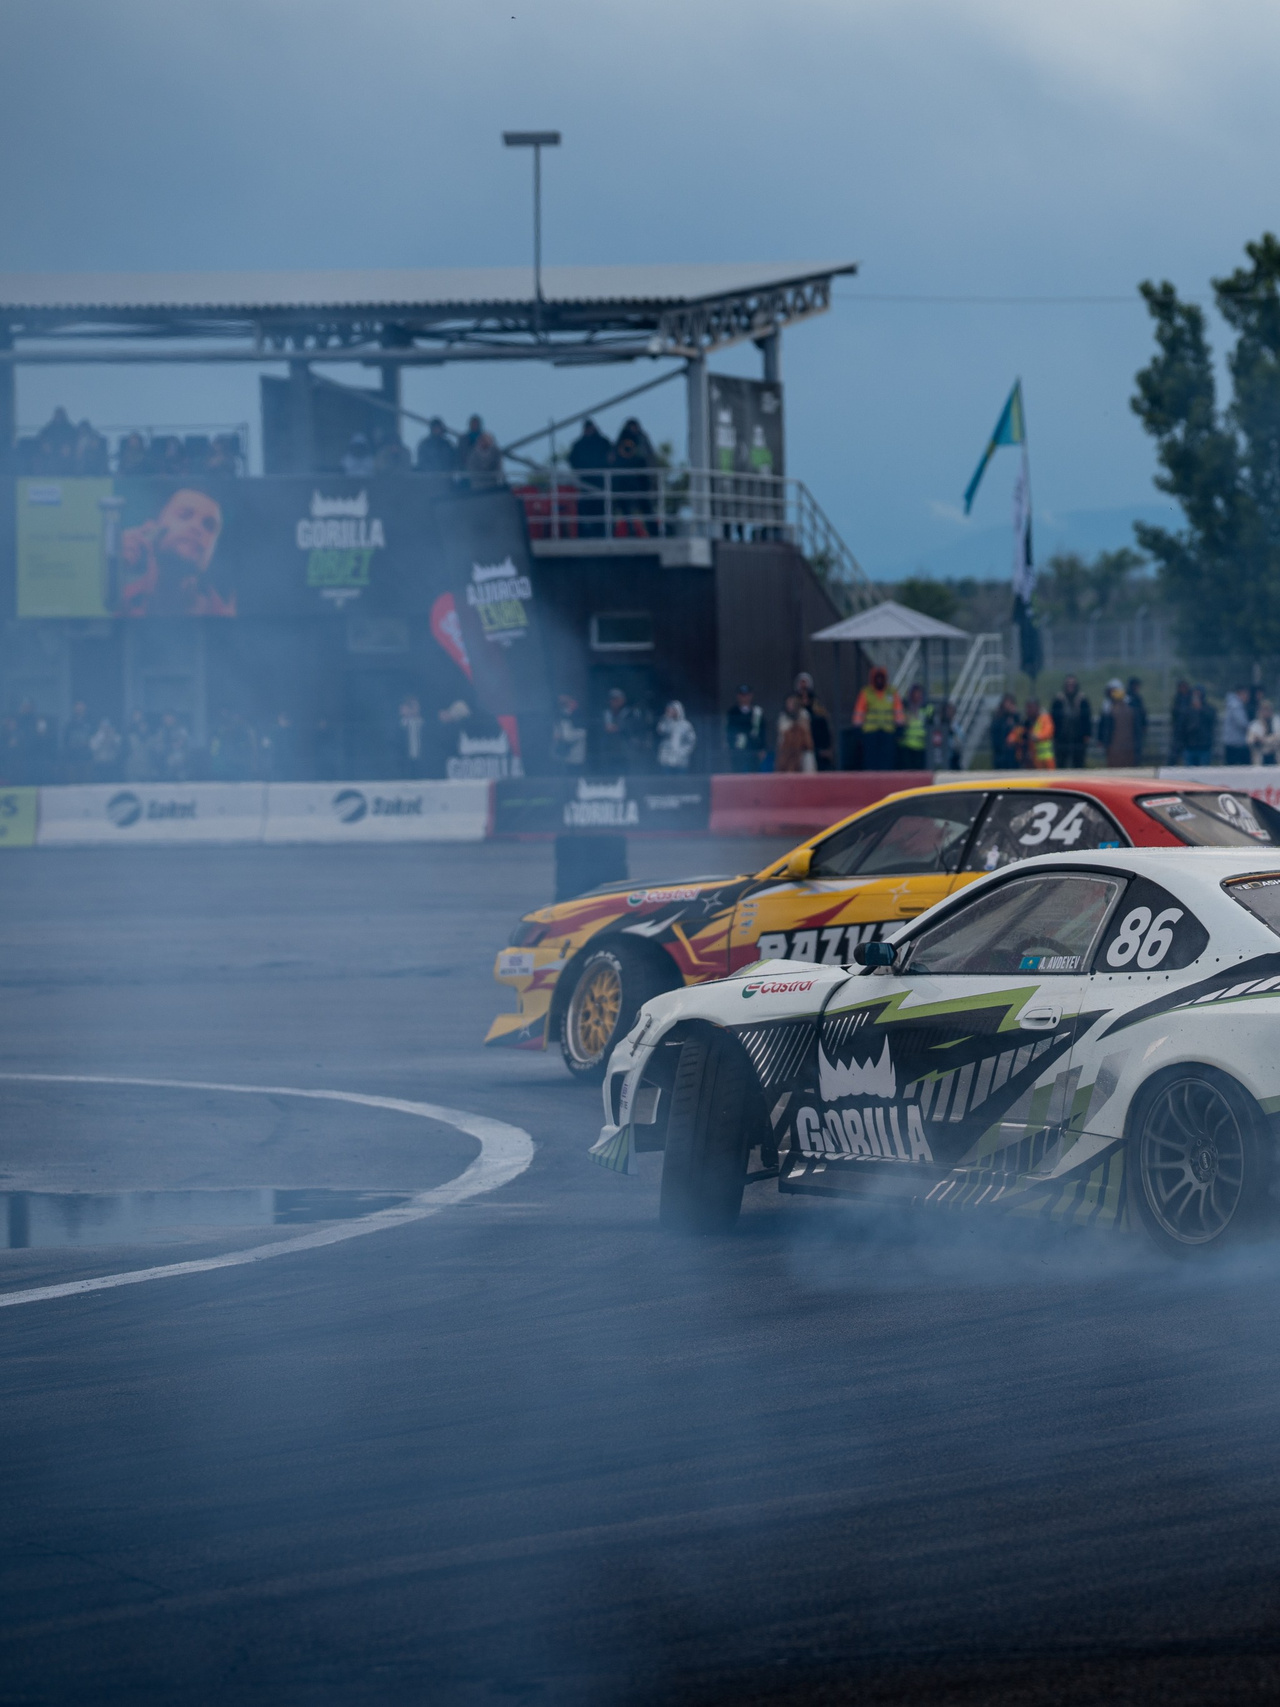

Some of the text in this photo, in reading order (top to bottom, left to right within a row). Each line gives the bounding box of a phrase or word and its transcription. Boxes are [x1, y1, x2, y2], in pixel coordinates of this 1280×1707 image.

[297, 518, 385, 549] GORILLA
[1019, 802, 1088, 846] 34
[1106, 906, 1184, 969] 86
[1047, 954, 1080, 969] AVDEYEV
[761, 979, 819, 994] Castrol
[796, 1105, 935, 1163] GORILLA
